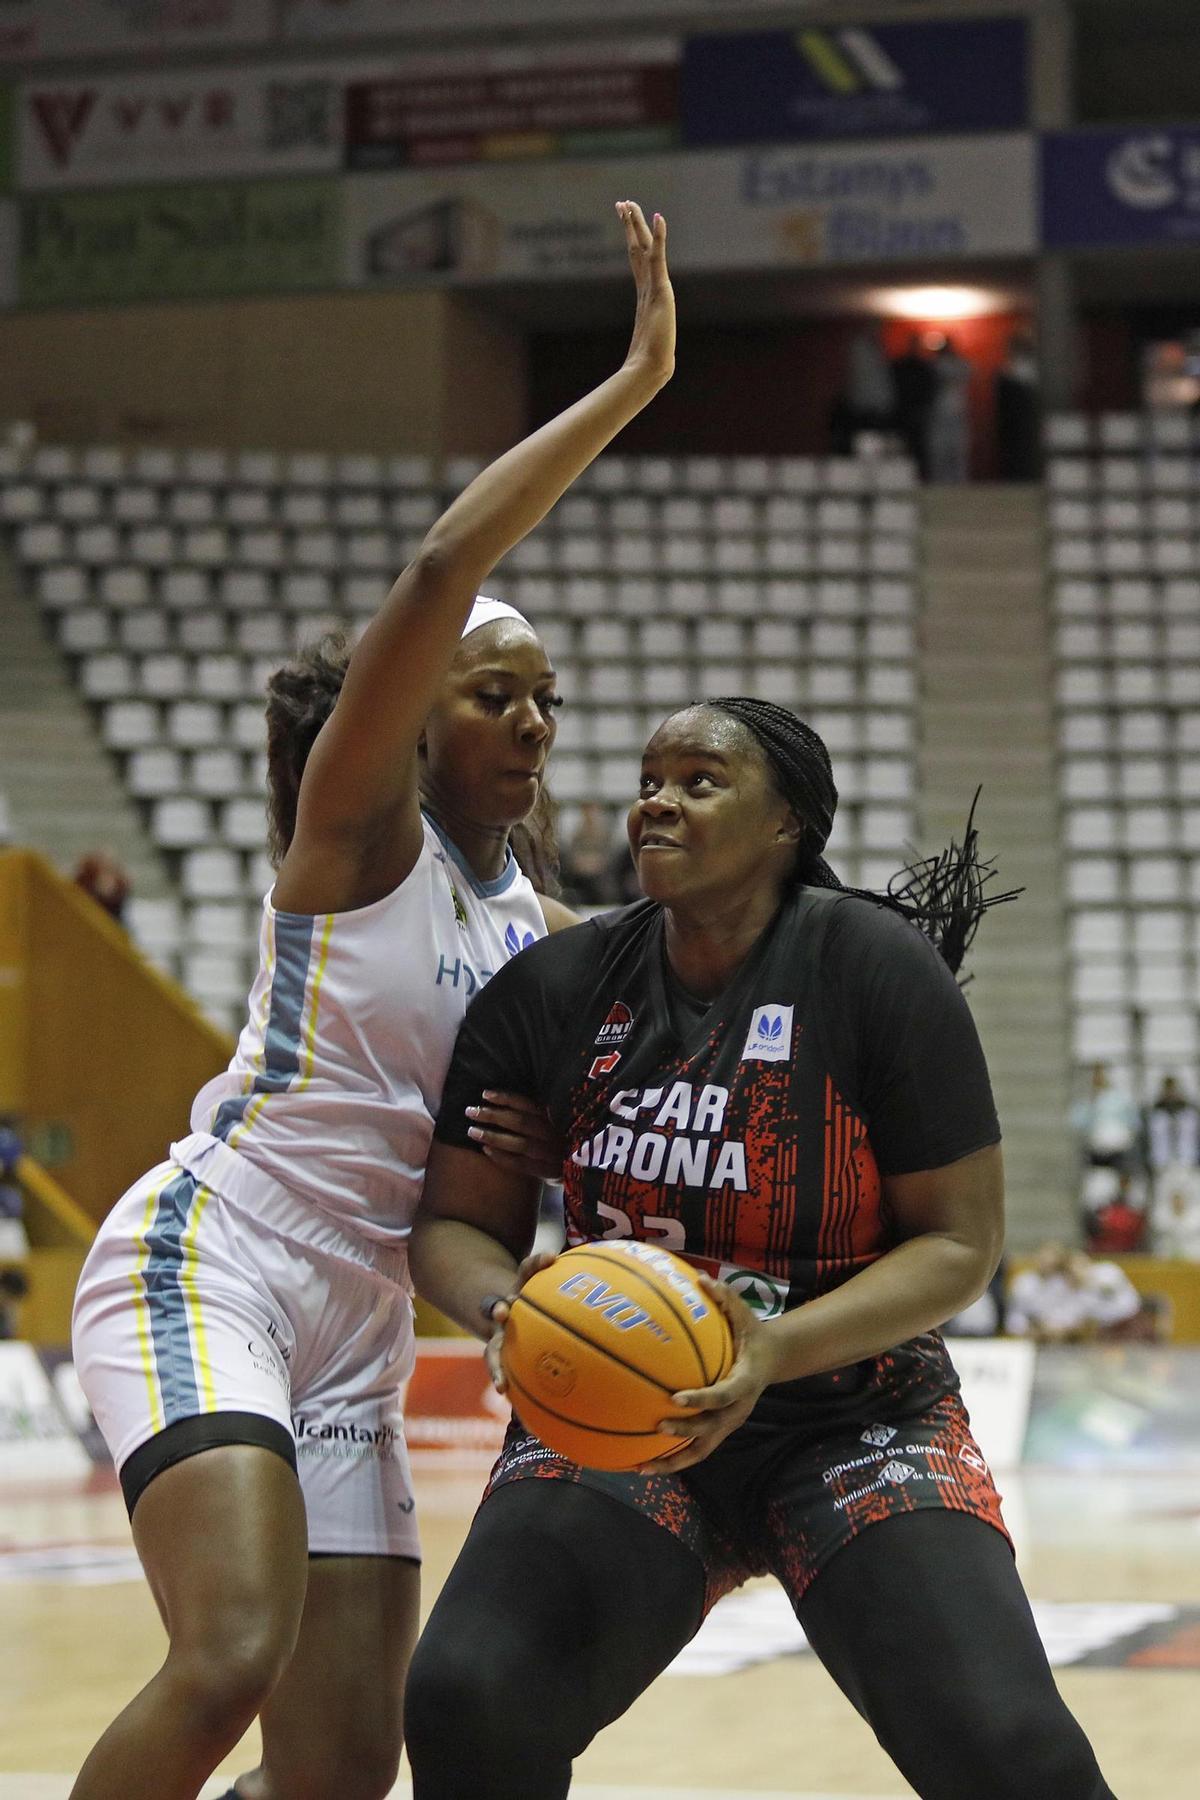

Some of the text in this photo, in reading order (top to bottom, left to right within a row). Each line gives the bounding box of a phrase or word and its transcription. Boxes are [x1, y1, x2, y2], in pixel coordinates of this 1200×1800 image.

[599, 1022, 631, 1035] UNI
[557, 1271, 649, 1332] EVO
[821, 1445, 946, 1484] Diputació de Girona
[833, 1477, 886, 1511] Ajuntament
[913, 1472, 924, 1481] de
